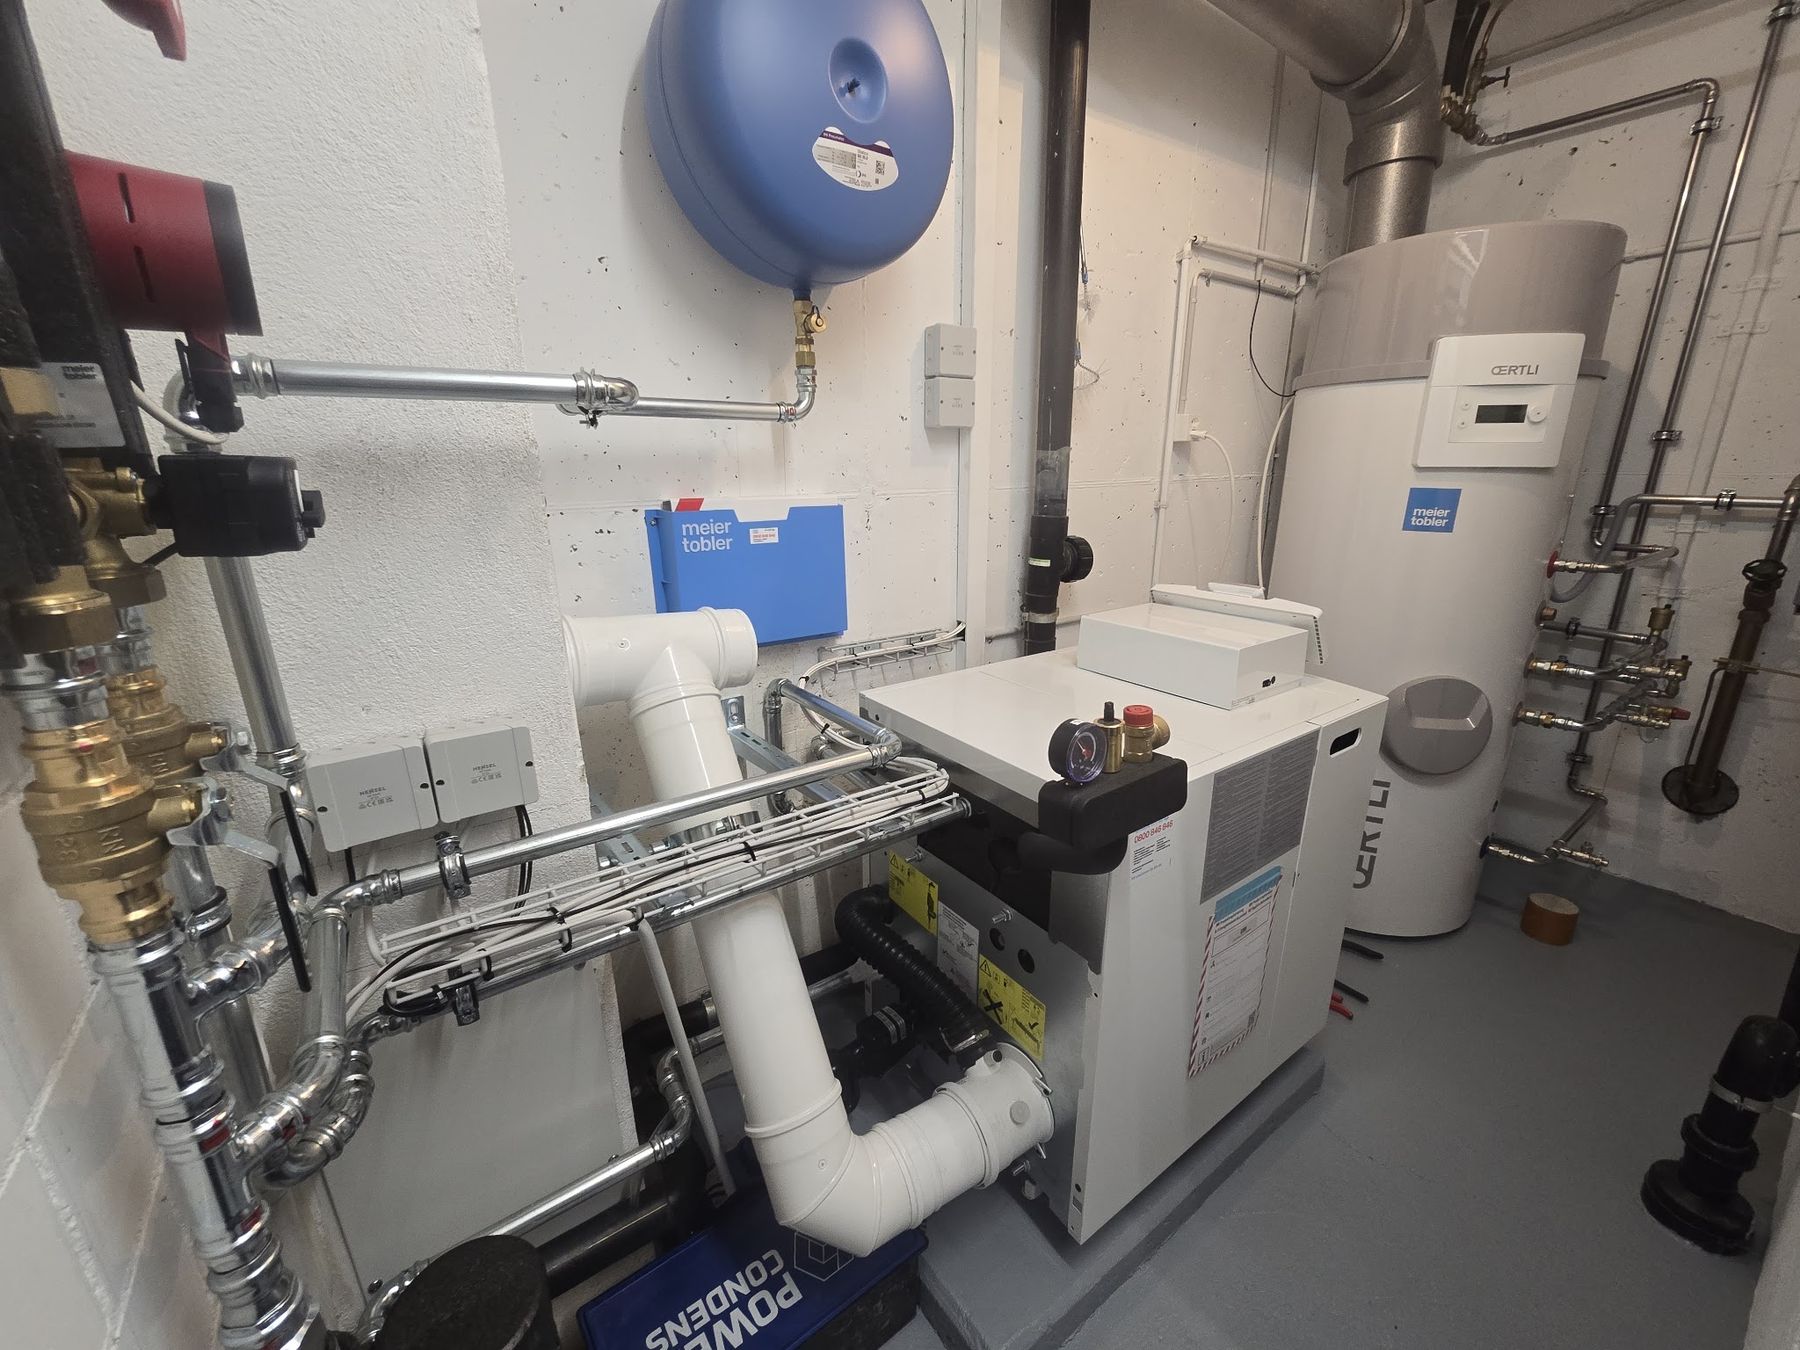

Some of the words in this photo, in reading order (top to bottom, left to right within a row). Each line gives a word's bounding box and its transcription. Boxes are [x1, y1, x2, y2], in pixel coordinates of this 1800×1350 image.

[1491, 364, 1539, 376] ŒRTLI
[1412, 506, 1451, 517] meier
[681, 519, 732, 536] meier
[1410, 516, 1449, 527] tobler
[681, 536, 733, 553] tobler
[645, 1249, 784, 1350] CONDENS
